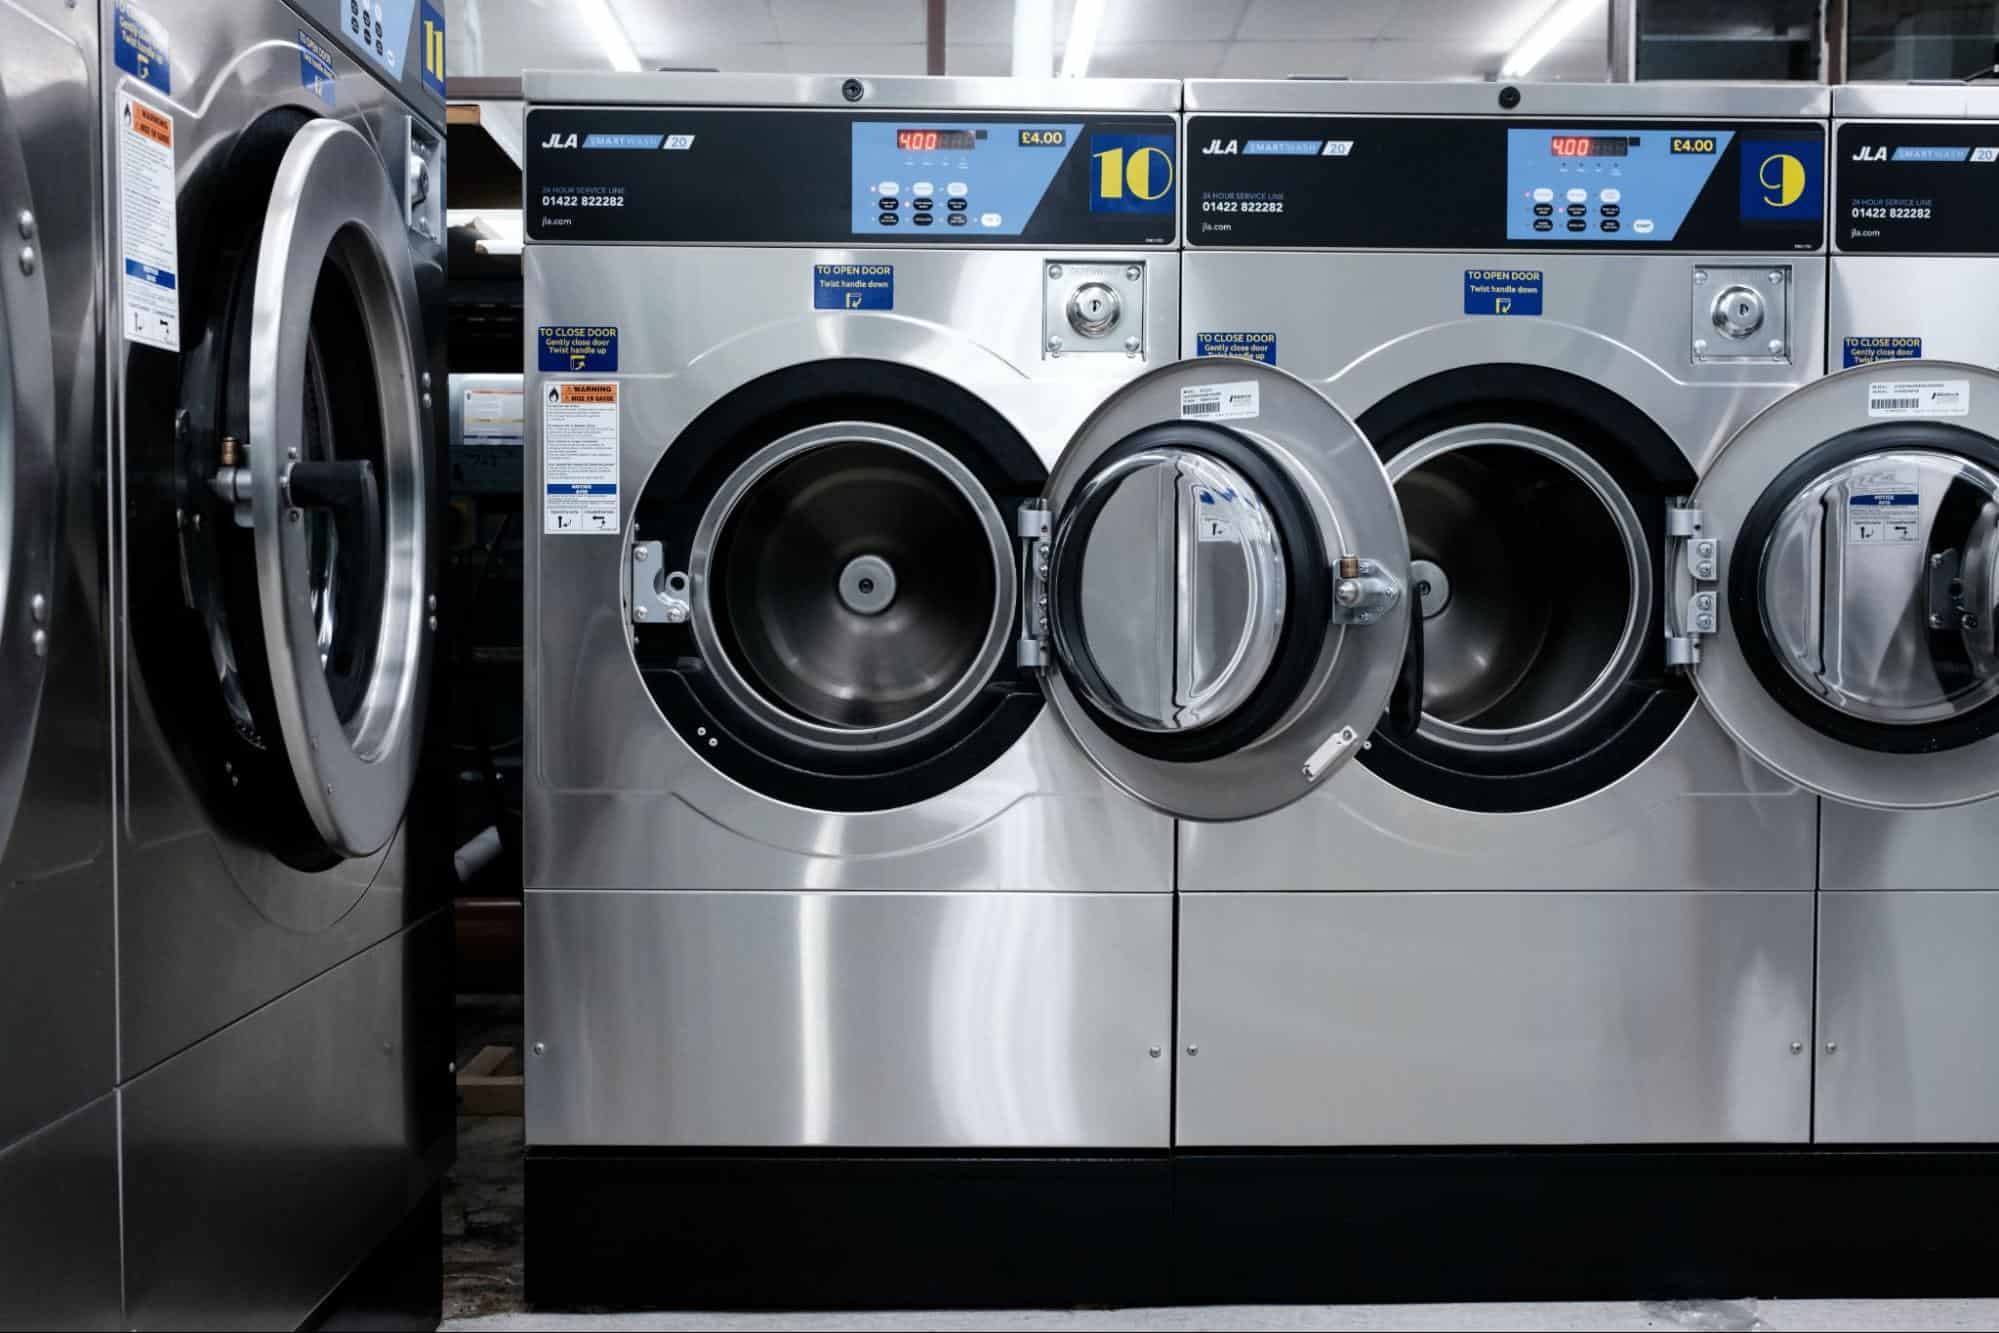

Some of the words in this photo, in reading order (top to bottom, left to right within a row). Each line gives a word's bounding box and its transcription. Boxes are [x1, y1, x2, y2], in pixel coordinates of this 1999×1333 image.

[423, 20, 444, 83] 11
[541, 133, 578, 148] JLA
[671, 136, 687, 147] 20
[1021, 131, 1062, 145] £4.00
[1202, 139, 1238, 154] JLA
[1330, 143, 1345, 154] 20
[1672, 139, 1713, 152] £4.00
[1852, 145, 1888, 161] JLA
[1977, 150, 1993, 160] 20
[1092, 147, 1174, 201] 10
[1759, 153, 1806, 207] 9
[542, 196, 577, 206] 01422
[581, 196, 624, 206] 822282
[1202, 202, 1237, 212] 01422
[1240, 202, 1284, 212] 822282
[1851, 208, 1886, 218] 01422
[1889, 208, 1931, 218] 822282
[542, 216, 572, 227] jla.com
[1202, 222, 1232, 232] jla.com
[1851, 228, 1880, 238] jla.com
[816, 266, 831, 275] TO
[833, 266, 860, 275] OPEN
[862, 266, 890, 275] DOOR
[1468, 272, 1481, 280] TO
[1483, 272, 1510, 280] OPEN
[1511, 272, 1540, 280] DOOR
[819, 280, 840, 288] Twist
[842, 280, 866, 288] handle
[868, 280, 888, 288] down
[1470, 285, 1489, 293] Twist
[1491, 285, 1516, 293] handle
[1518, 285, 1538, 293] down
[540, 328, 553, 337] TO
[555, 328, 585, 337] CLOSE
[587, 328, 616, 337] DOOR
[545, 338, 570, 346] Gently
[571, 338, 590, 346] close
[592, 338, 610, 346] door
[1199, 334, 1212, 342] TO
[1214, 334, 1244, 342] CLOSE
[1246, 334, 1275, 342] DOOR
[1846, 338, 1858, 346] TO
[1861, 338, 1889, 346] CLOSE
[1892, 338, 1920, 346] DOOR
[1204, 344, 1229, 352] Gently
[1230, 344, 1249, 352] close
[1250, 344, 1268, 352] door
[1850, 348, 1876, 356] Gently
[1877, 348, 1895, 356] close
[1896, 348, 1914, 356] door
